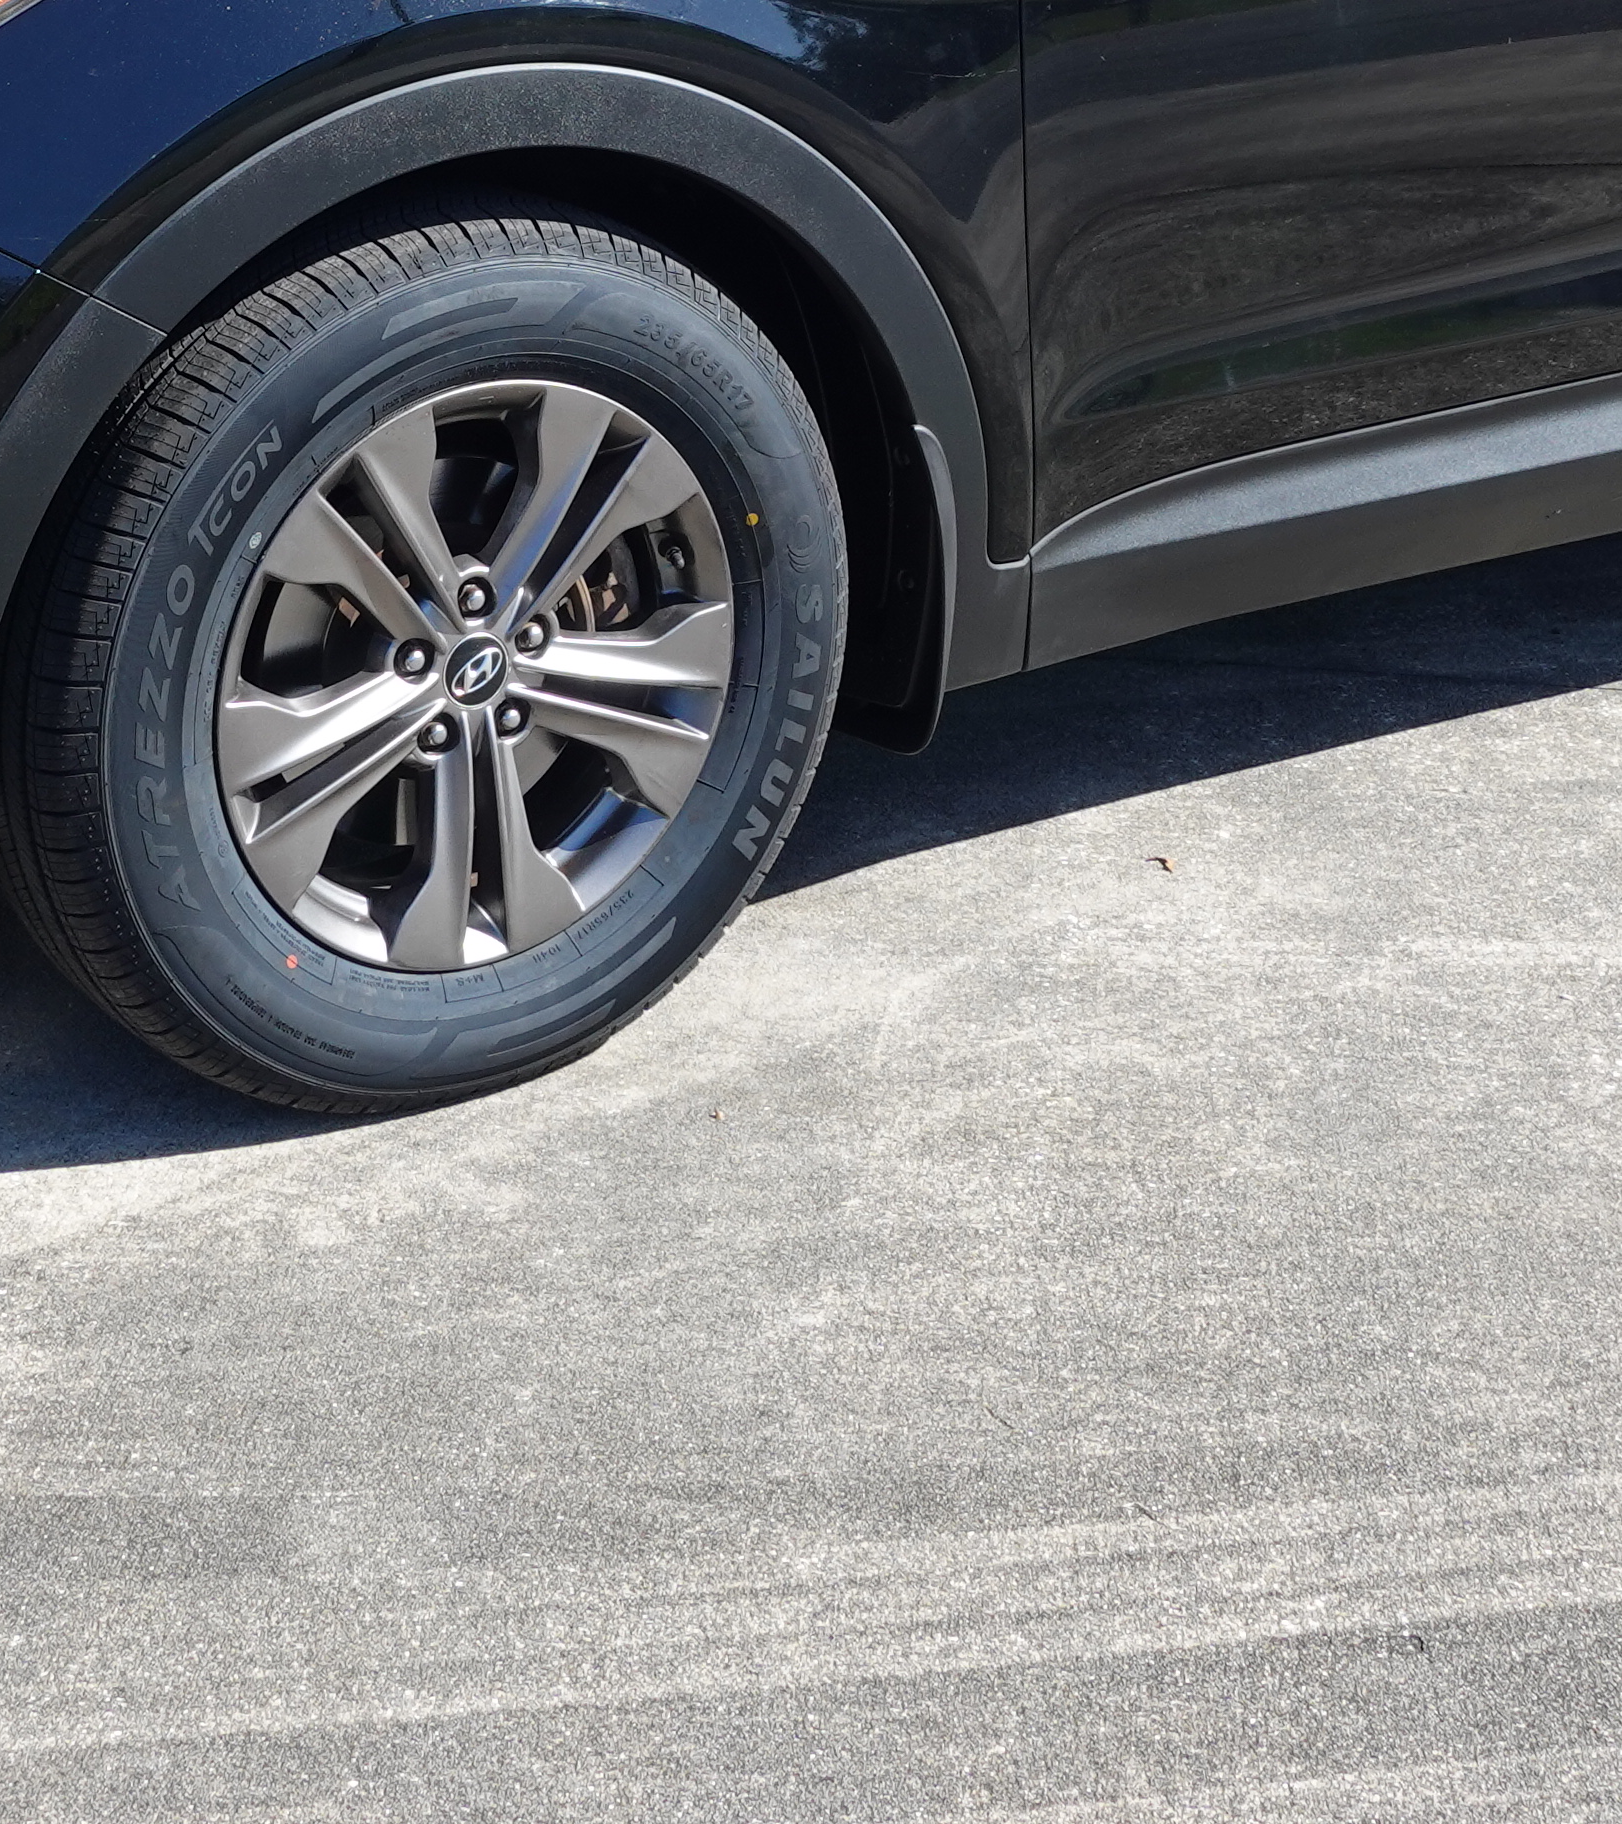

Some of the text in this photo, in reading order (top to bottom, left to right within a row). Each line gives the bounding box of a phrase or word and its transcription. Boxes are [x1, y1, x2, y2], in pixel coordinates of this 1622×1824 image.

[633, 314, 754, 410] 235/65R17
[135, 564, 202, 912] ATREZZO
[732, 583, 824, 862] SAILUN
